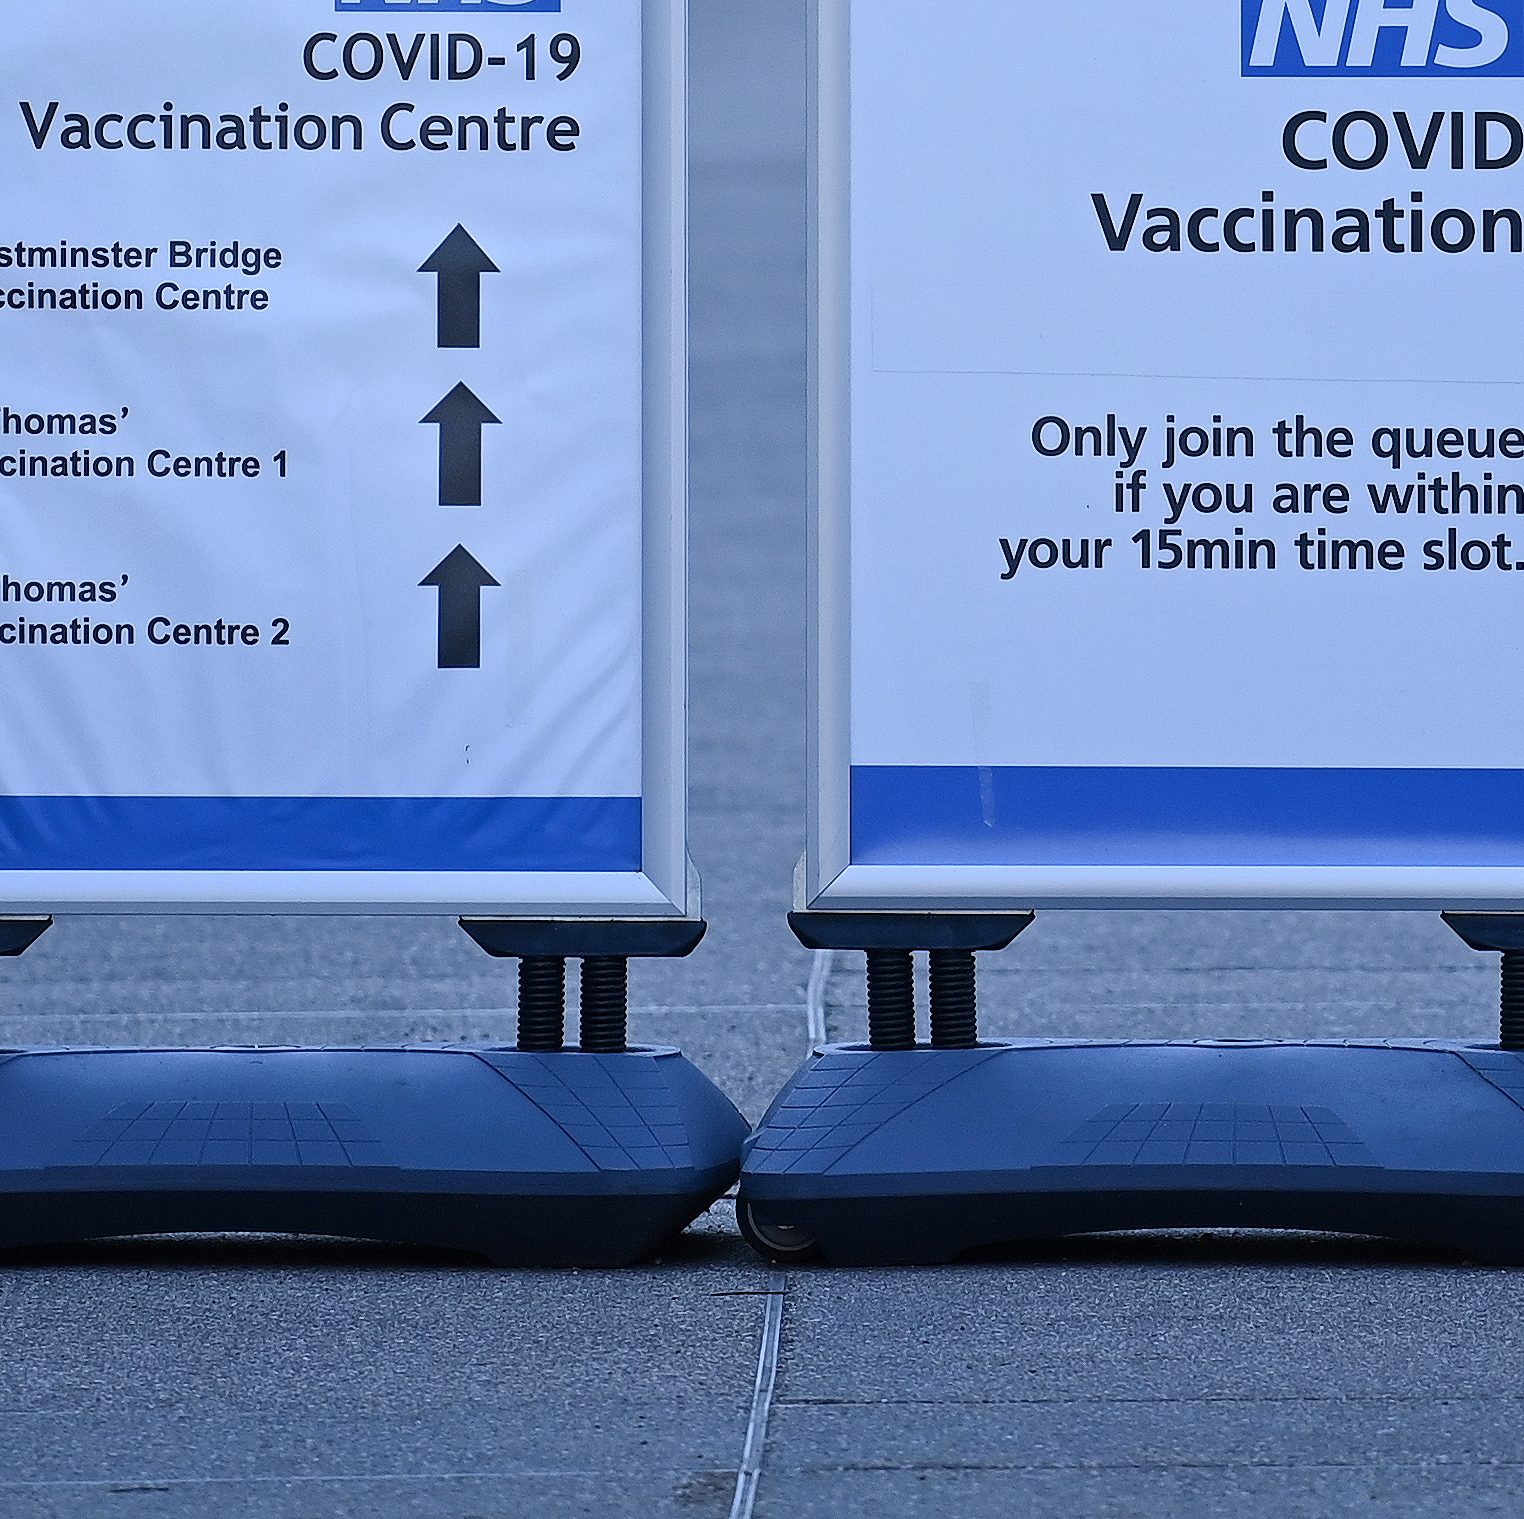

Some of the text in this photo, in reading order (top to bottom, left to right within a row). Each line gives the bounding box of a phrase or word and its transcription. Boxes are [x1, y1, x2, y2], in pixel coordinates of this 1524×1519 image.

[303, 32, 581, 82] COVID-19
[18, 101, 580, 152] Vaccination Centre
[1282, 110, 1524, 171] COVID
[1090, 190, 1523, 254] Vaccination
[169, 240, 282, 276] Bridge
[155, 282, 269, 311] Centre
[147, 449, 261, 478] Centre
[273, 449, 286, 478] 1
[1031, 413, 1148, 469] Only
[1161, 414, 1254, 469] join
[1271, 414, 1354, 458] the
[1114, 469, 1524, 525] if you are within
[998, 527, 1524, 581] your 15min time slot.
[147, 616, 260, 646] Centre
[270, 617, 290, 646] 2
